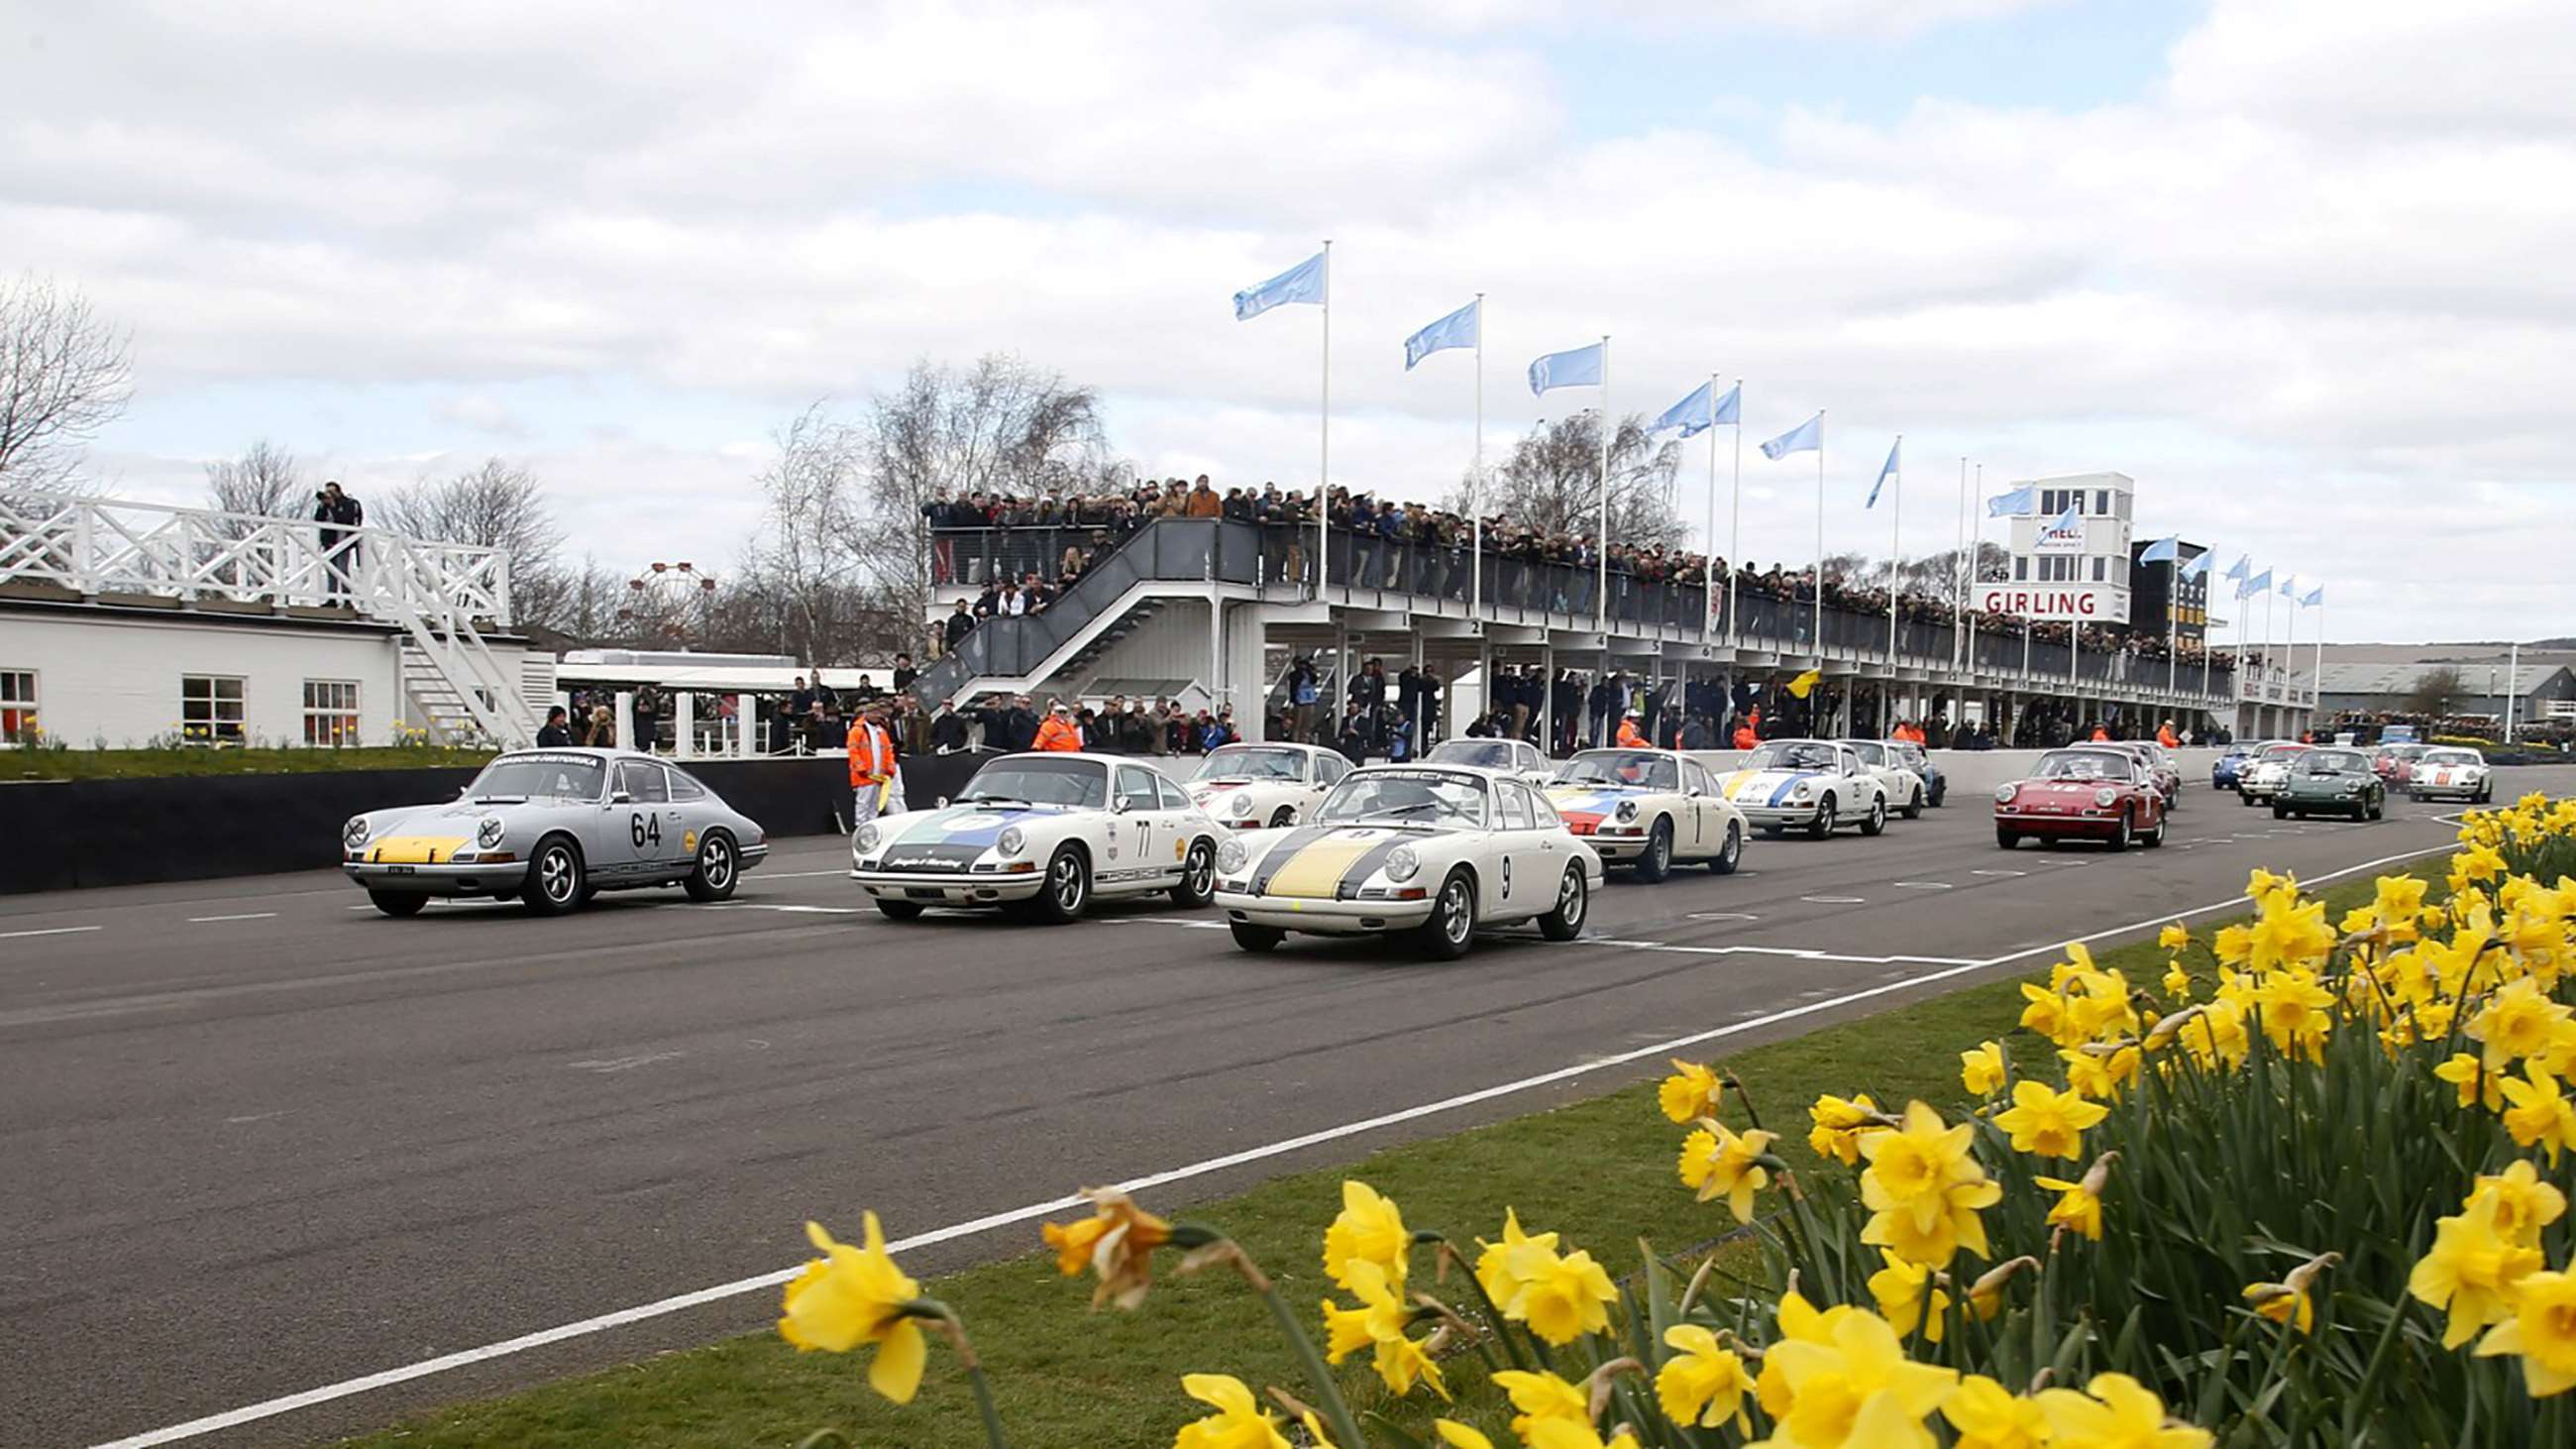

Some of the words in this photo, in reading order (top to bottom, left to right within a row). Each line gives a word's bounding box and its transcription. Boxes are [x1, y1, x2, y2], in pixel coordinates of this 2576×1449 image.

[1986, 592, 2095, 614] GIRLING
[1471, 620, 1480, 634] 2
[1538, 627, 1546, 641] 3
[1596, 635, 1605, 646] 4
[1652, 640, 1660, 652] 5
[1350, 770, 1474, 786] PORSCHE
[631, 811, 662, 848] 64
[1135, 820, 1151, 858] 77
[1501, 854, 1511, 900] 9
